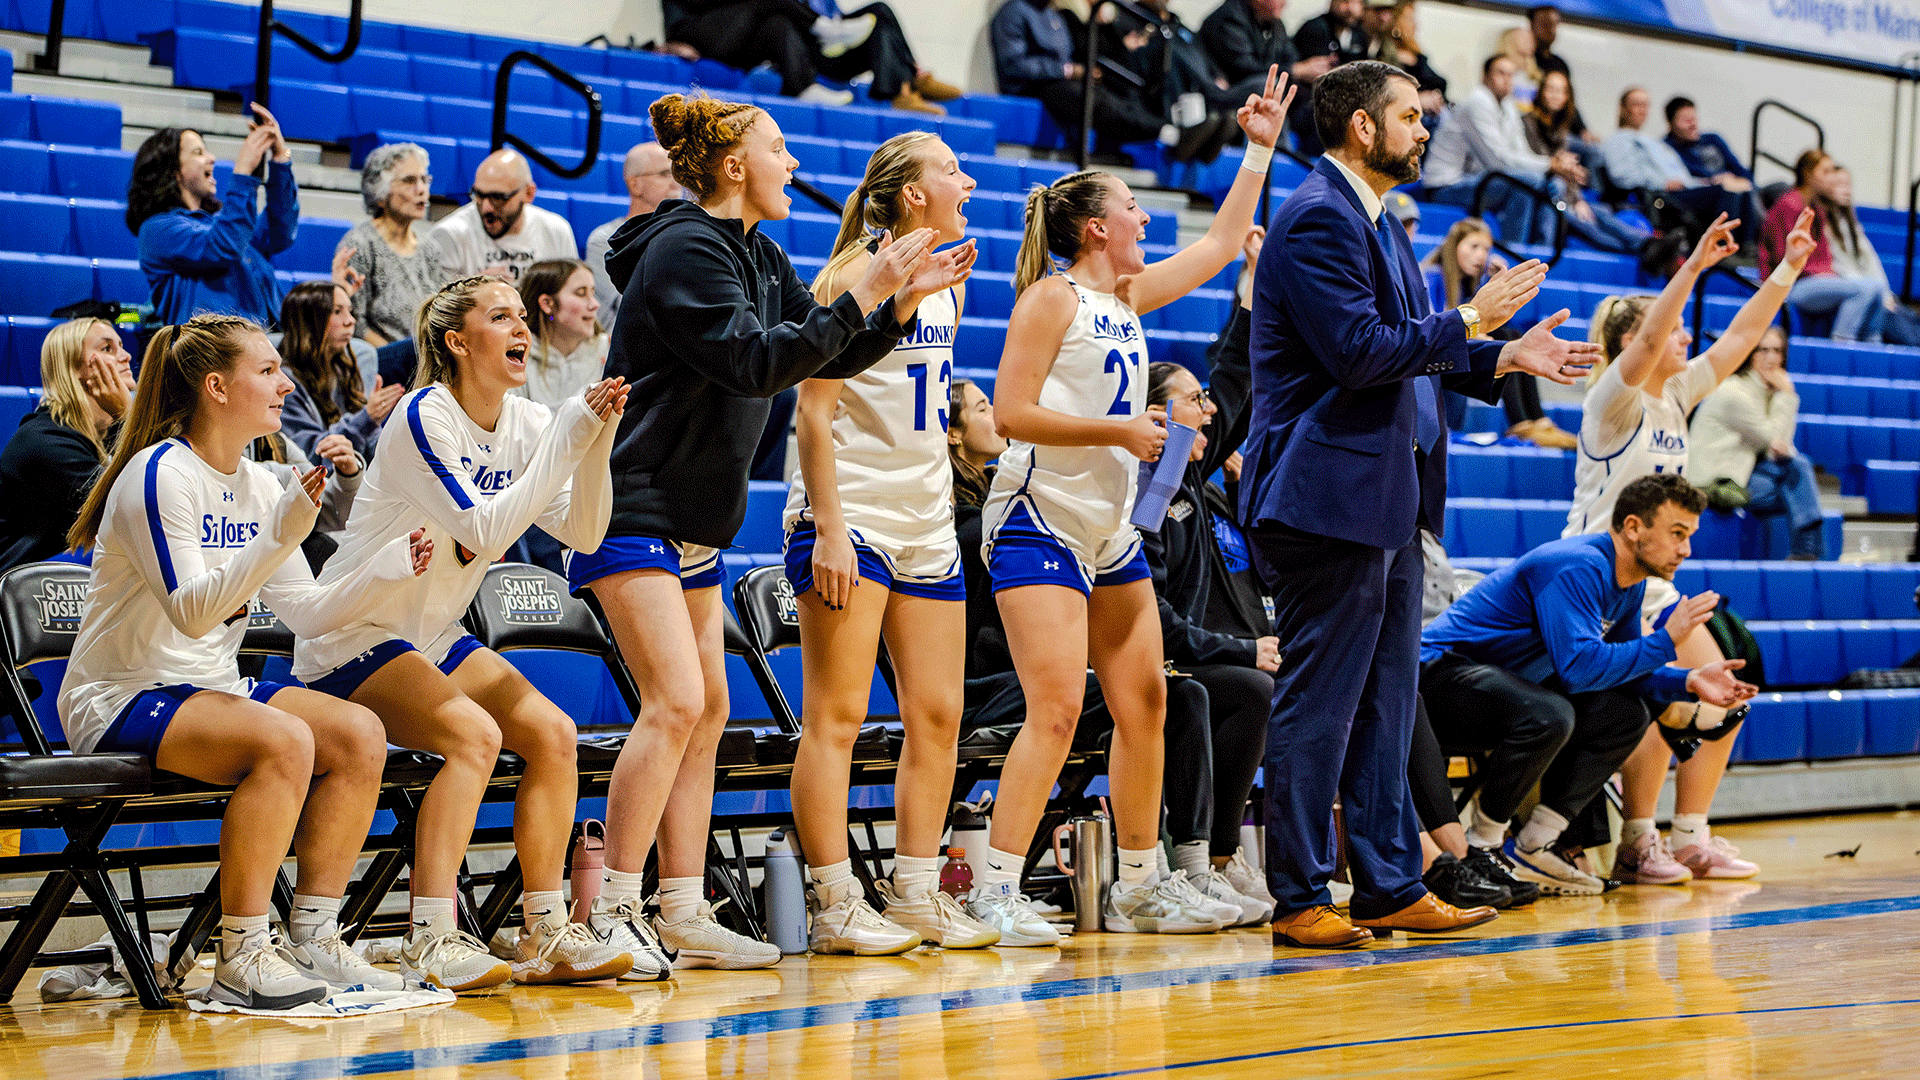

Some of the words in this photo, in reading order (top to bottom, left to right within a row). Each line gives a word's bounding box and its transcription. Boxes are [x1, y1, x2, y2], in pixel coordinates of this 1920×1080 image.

[906, 360, 952, 433] 13
[503, 578, 545, 595] SAINT
[502, 594, 559, 619] JOSEPH'S
[515, 614, 553, 622] MONKS
